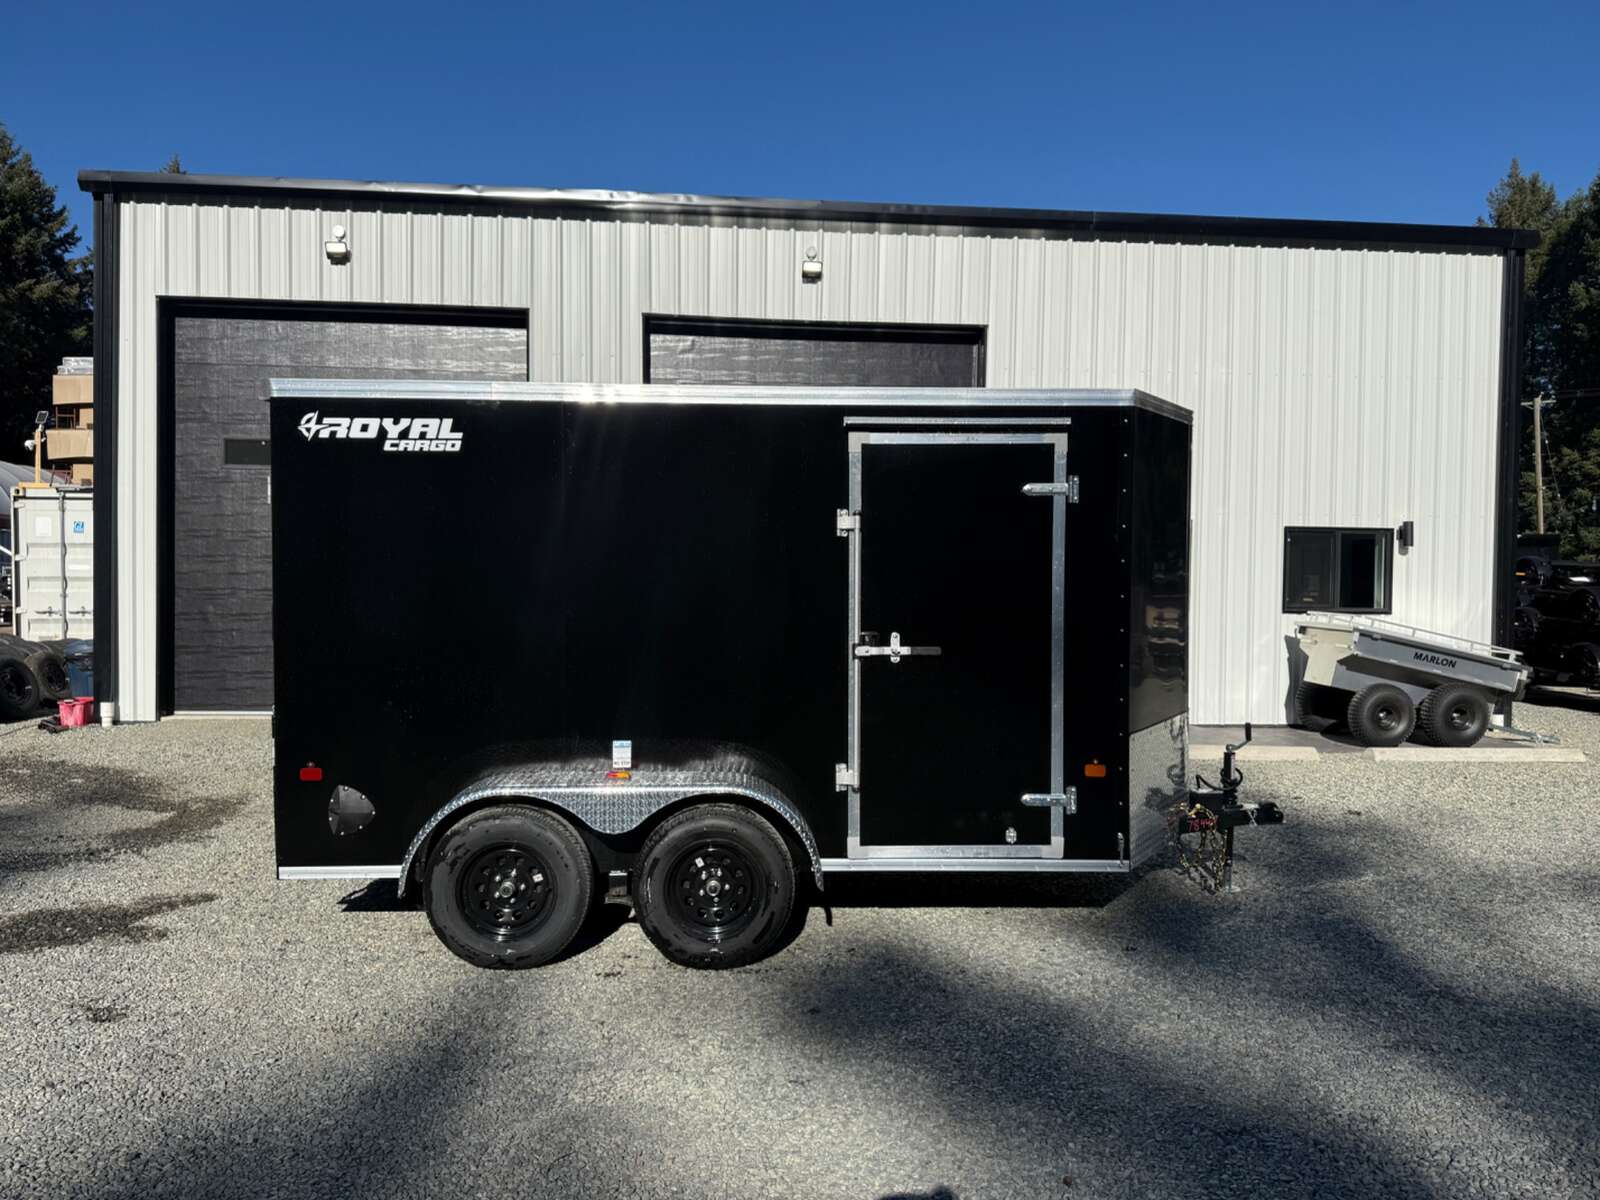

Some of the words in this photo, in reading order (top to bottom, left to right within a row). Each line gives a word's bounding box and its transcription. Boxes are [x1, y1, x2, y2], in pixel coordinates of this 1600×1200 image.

[319, 417, 463, 439] ROYAL
[384, 440, 462, 452] CARGO
[1413, 652, 1457, 668] MARLON
